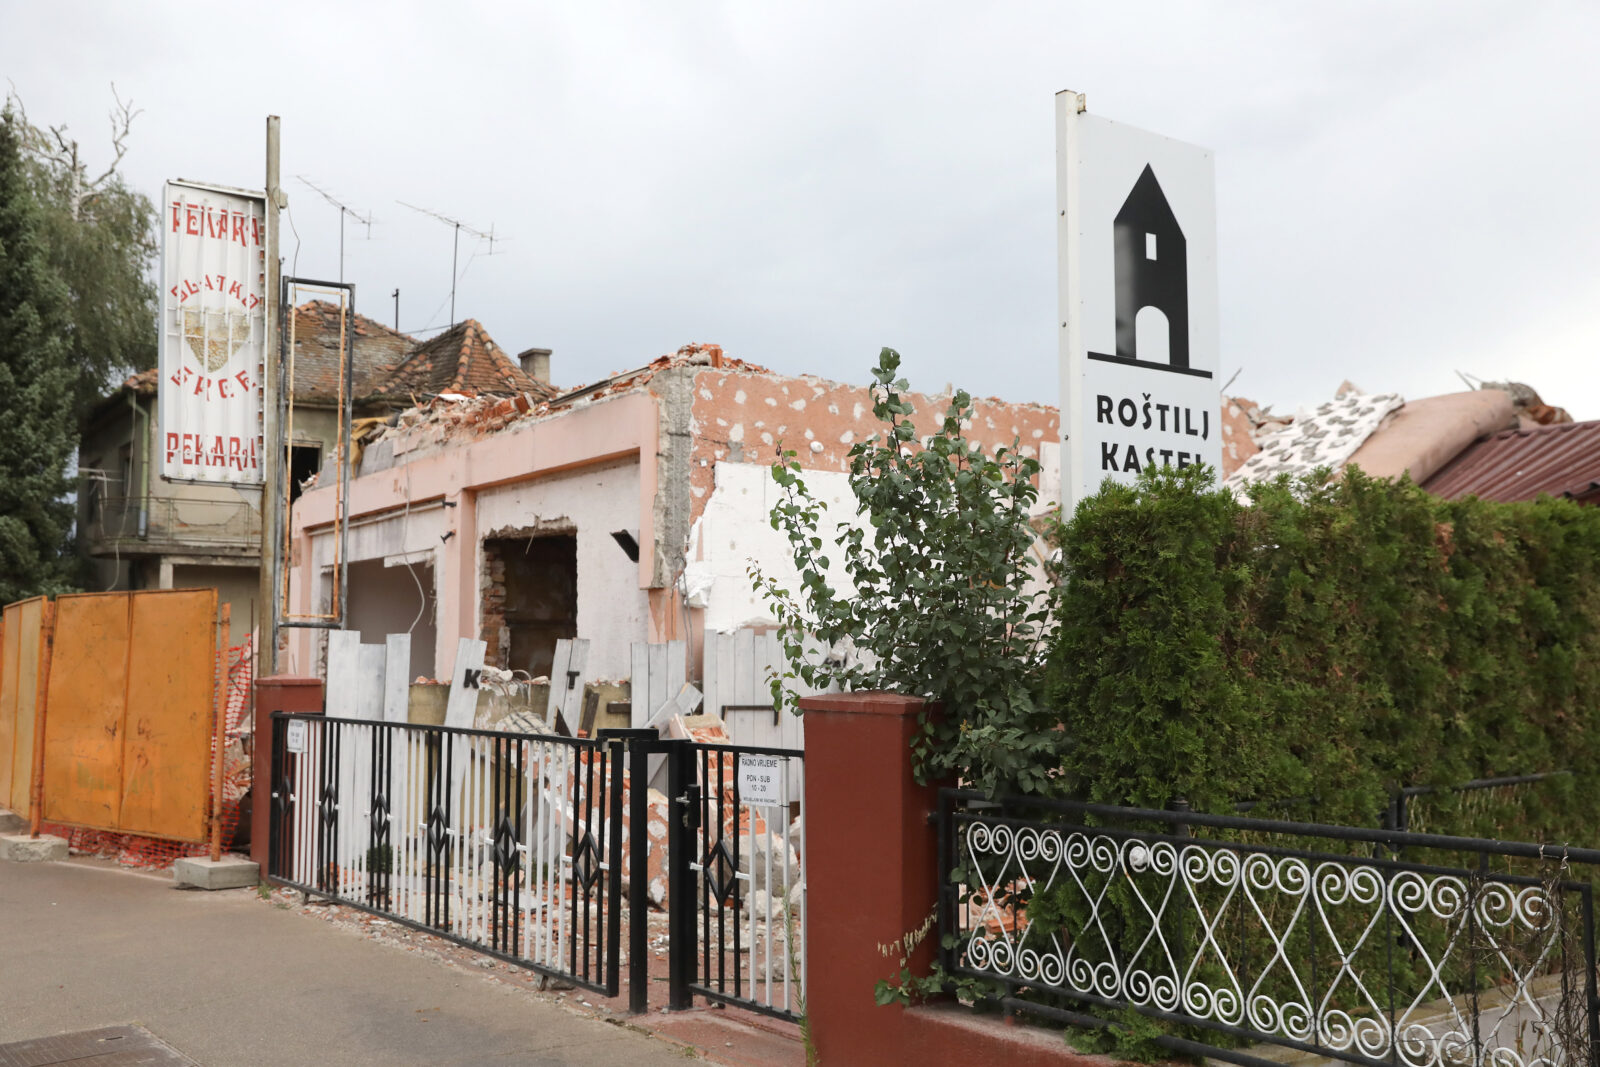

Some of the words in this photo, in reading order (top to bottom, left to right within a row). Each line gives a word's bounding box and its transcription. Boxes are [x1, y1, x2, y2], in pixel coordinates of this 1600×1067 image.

[1097, 392, 1209, 441] ROŠTILJ
[166, 432, 257, 472] PEKARA
[463, 668, 481, 689] K
[566, 670, 580, 690] T
[746, 774, 757, 782] PON
[760, 775, 771, 783] SUB
